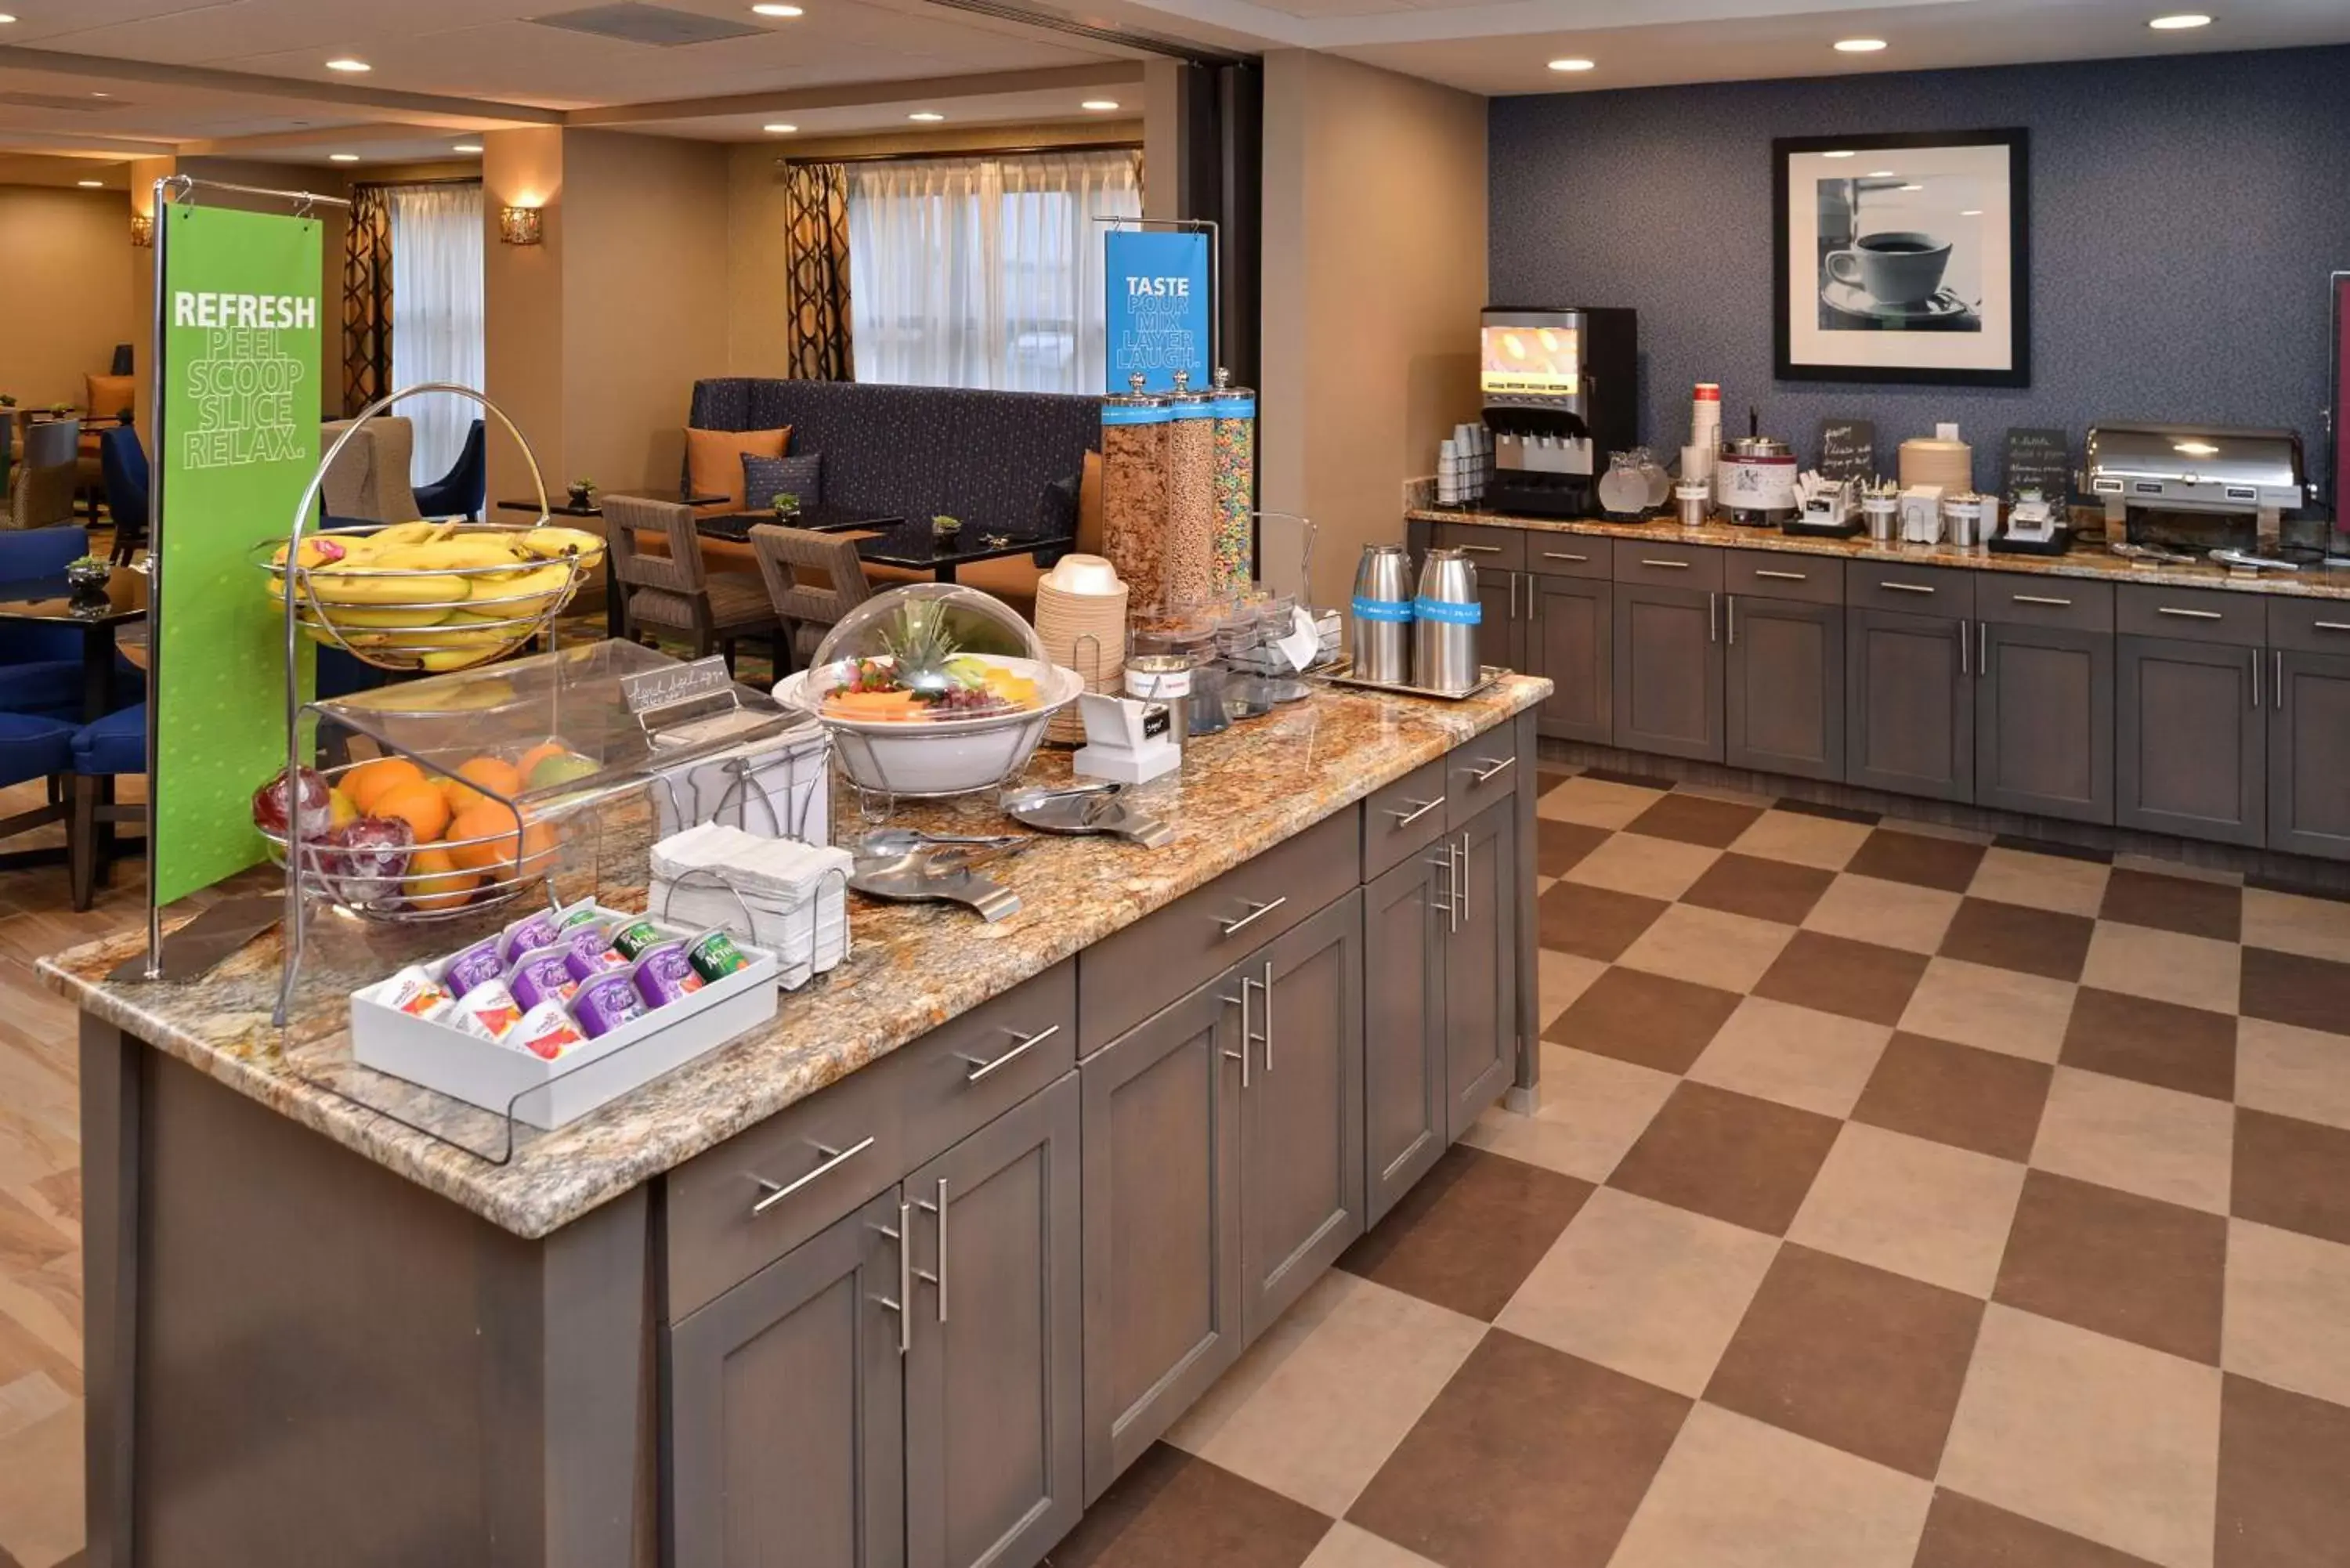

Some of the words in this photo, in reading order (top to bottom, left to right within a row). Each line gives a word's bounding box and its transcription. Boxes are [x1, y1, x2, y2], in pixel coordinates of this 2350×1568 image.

[1126, 277, 1190, 296] TASTE
[175, 291, 316, 329] REFRESH
[1127, 294, 1188, 313] POUR
[1136, 313, 1182, 331] MIX
[207, 326, 287, 362] PEEL
[1123, 330, 1193, 349] LAYER
[1117, 348, 1201, 369] LAUGH.
[188, 359, 305, 399] SCOOP
[198, 392, 293, 432] SLICE
[184, 425, 306, 470] RELAX.
